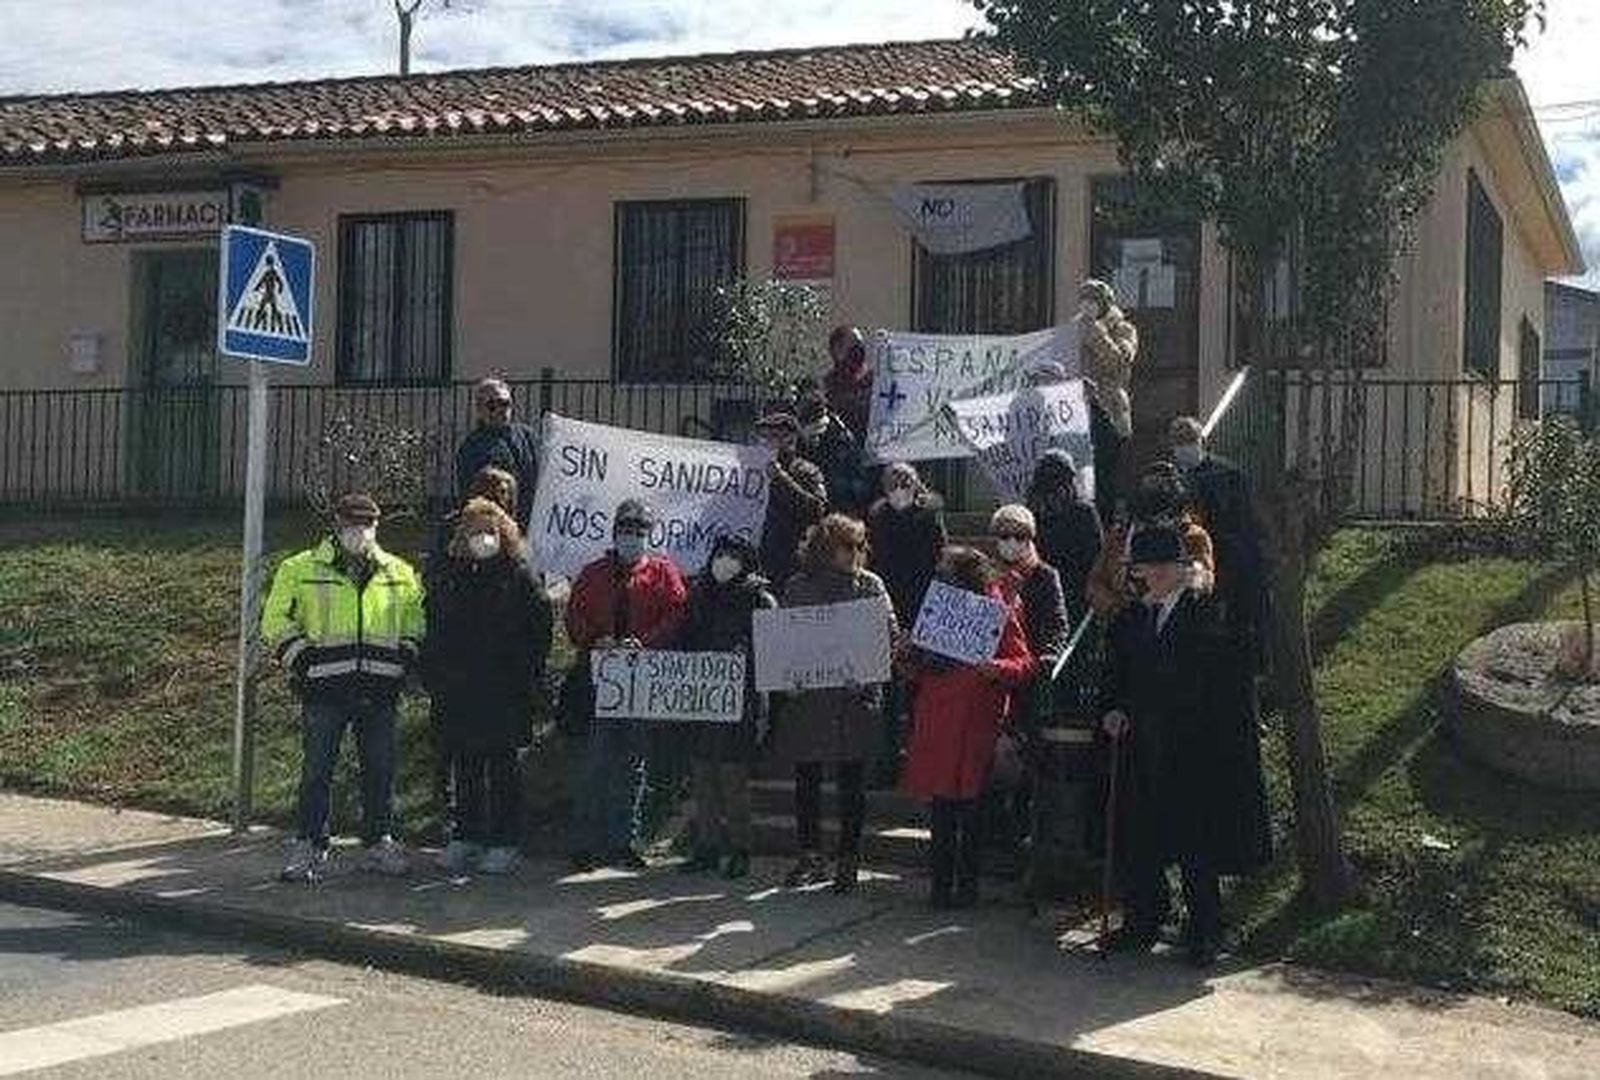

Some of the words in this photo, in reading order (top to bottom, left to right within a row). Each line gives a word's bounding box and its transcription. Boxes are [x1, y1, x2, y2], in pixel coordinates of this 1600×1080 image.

[123, 202, 231, 228] FARMACI
[561, 444, 609, 482] SIN
[640, 457, 766, 499] SANIDAD
[547, 503, 609, 541] NOS
